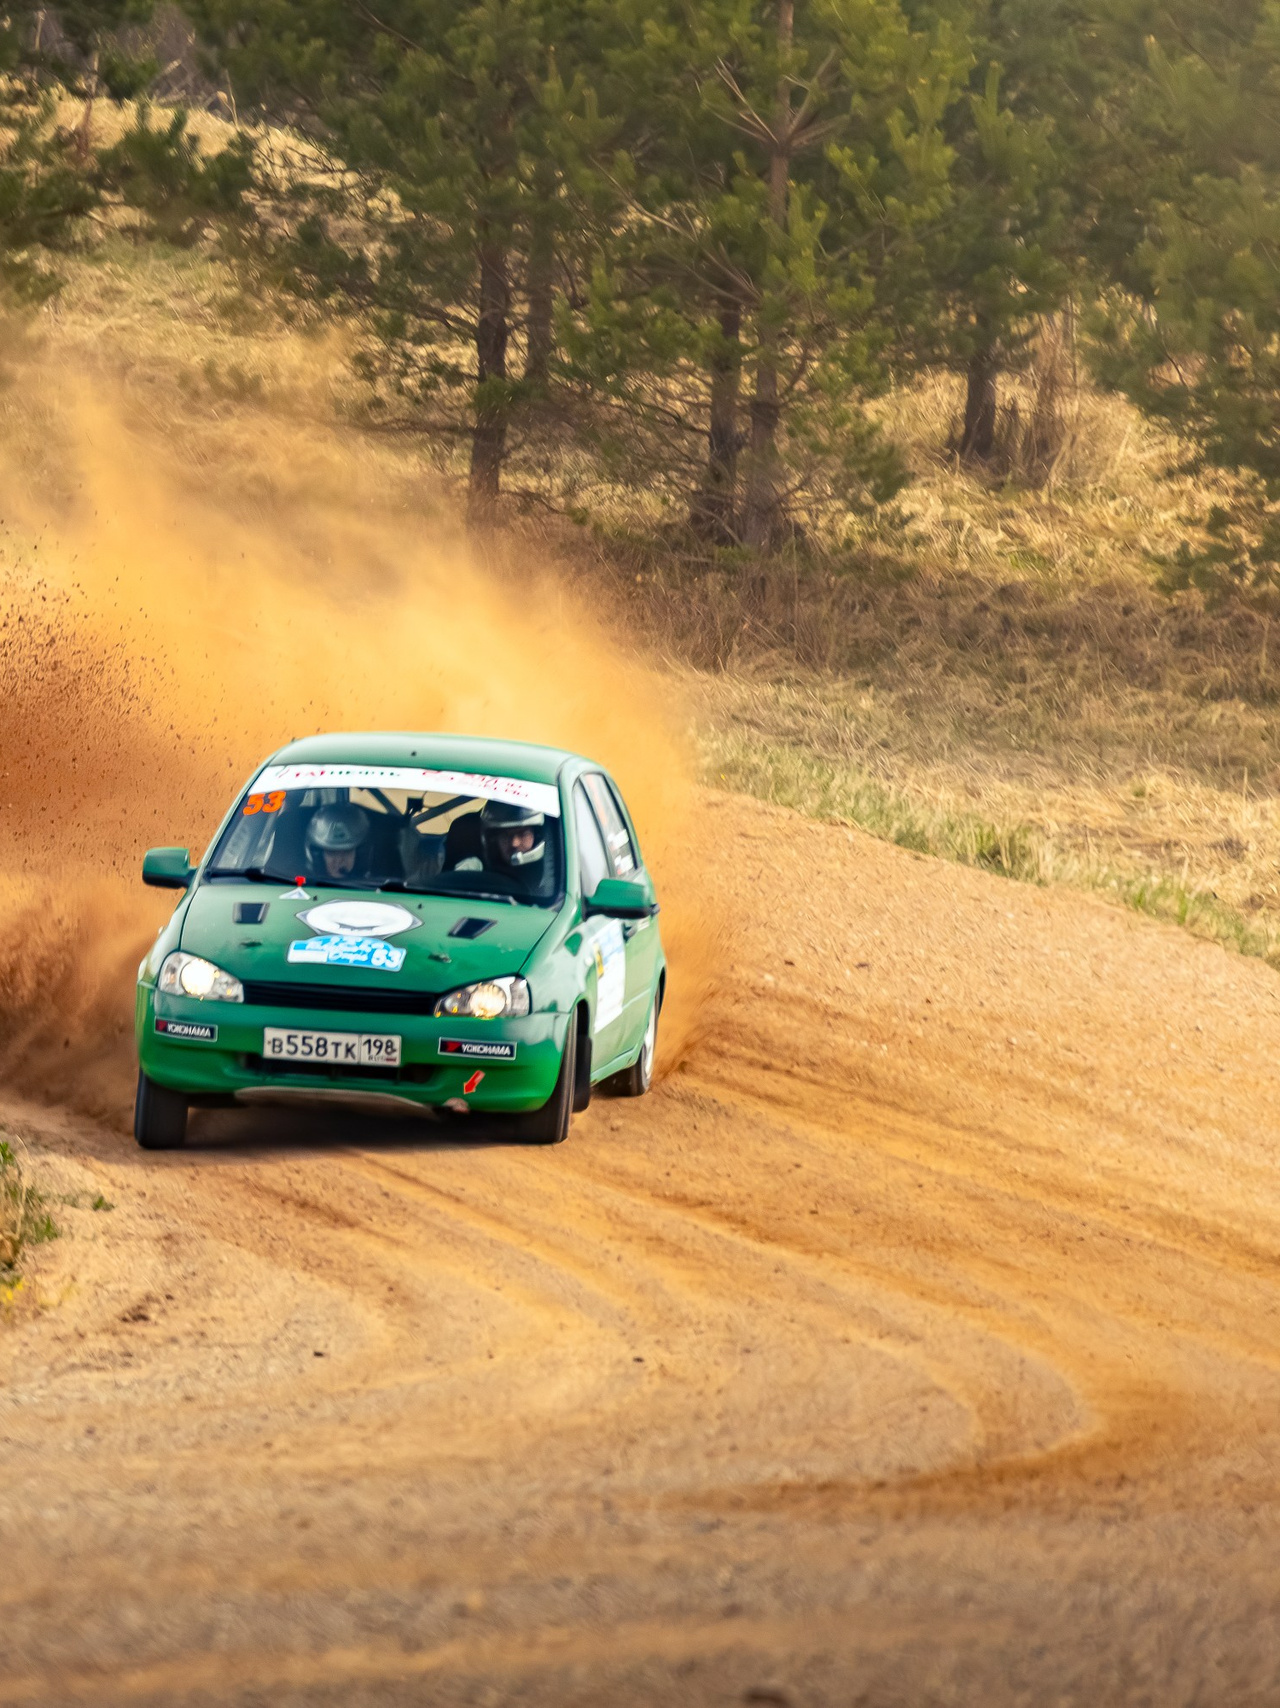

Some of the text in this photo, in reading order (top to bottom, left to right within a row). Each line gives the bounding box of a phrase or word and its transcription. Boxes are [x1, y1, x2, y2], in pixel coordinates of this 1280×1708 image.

[242, 790, 287, 816] 53
[167, 1022, 211, 1038] YOKOHAMA
[461, 1043, 512, 1056] YOKOHAMA
